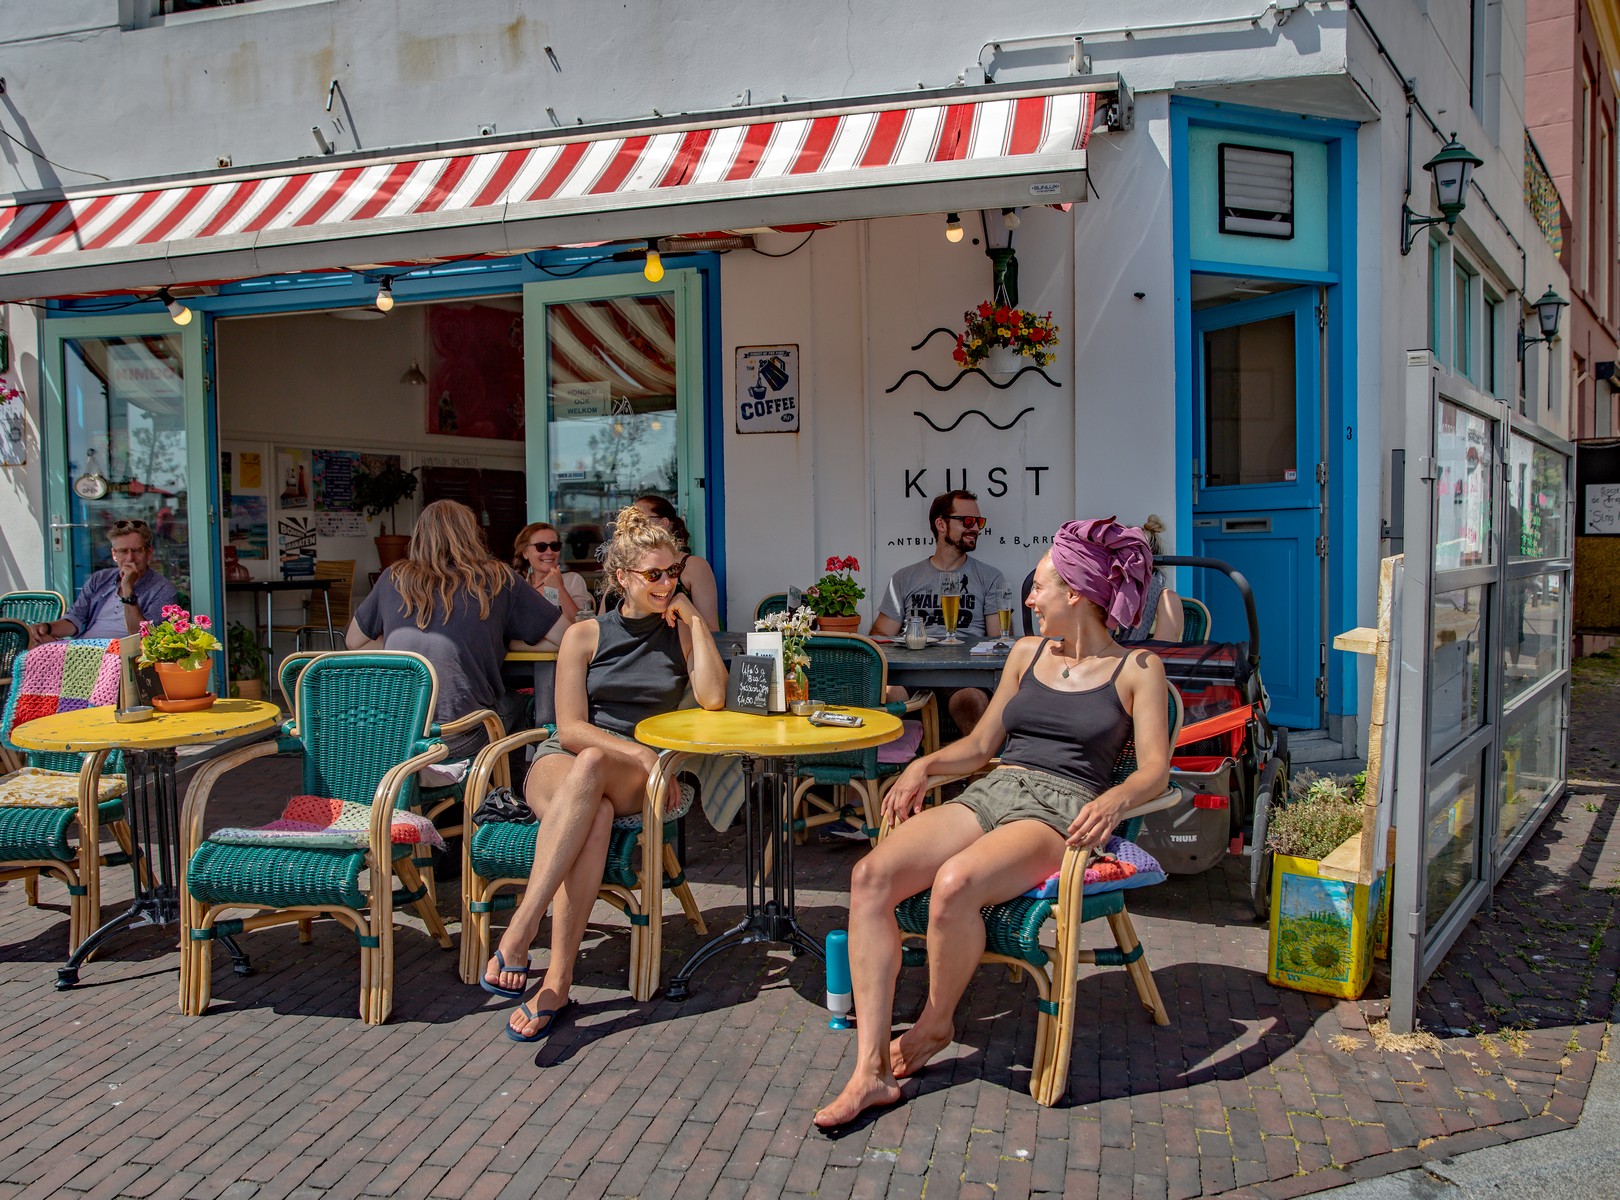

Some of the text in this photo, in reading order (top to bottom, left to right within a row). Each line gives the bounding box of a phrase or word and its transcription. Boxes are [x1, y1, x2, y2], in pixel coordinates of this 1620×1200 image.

[567, 388, 597, 396] HONDEN
[567, 407, 598, 415] WELKOM
[740, 397, 796, 421] COFFEE
[1346, 426, 1353, 440] 3
[904, 466, 1050, 499] KUST
[911, 594, 976, 610] WALNG
[1170, 835, 1198, 843] THULE
